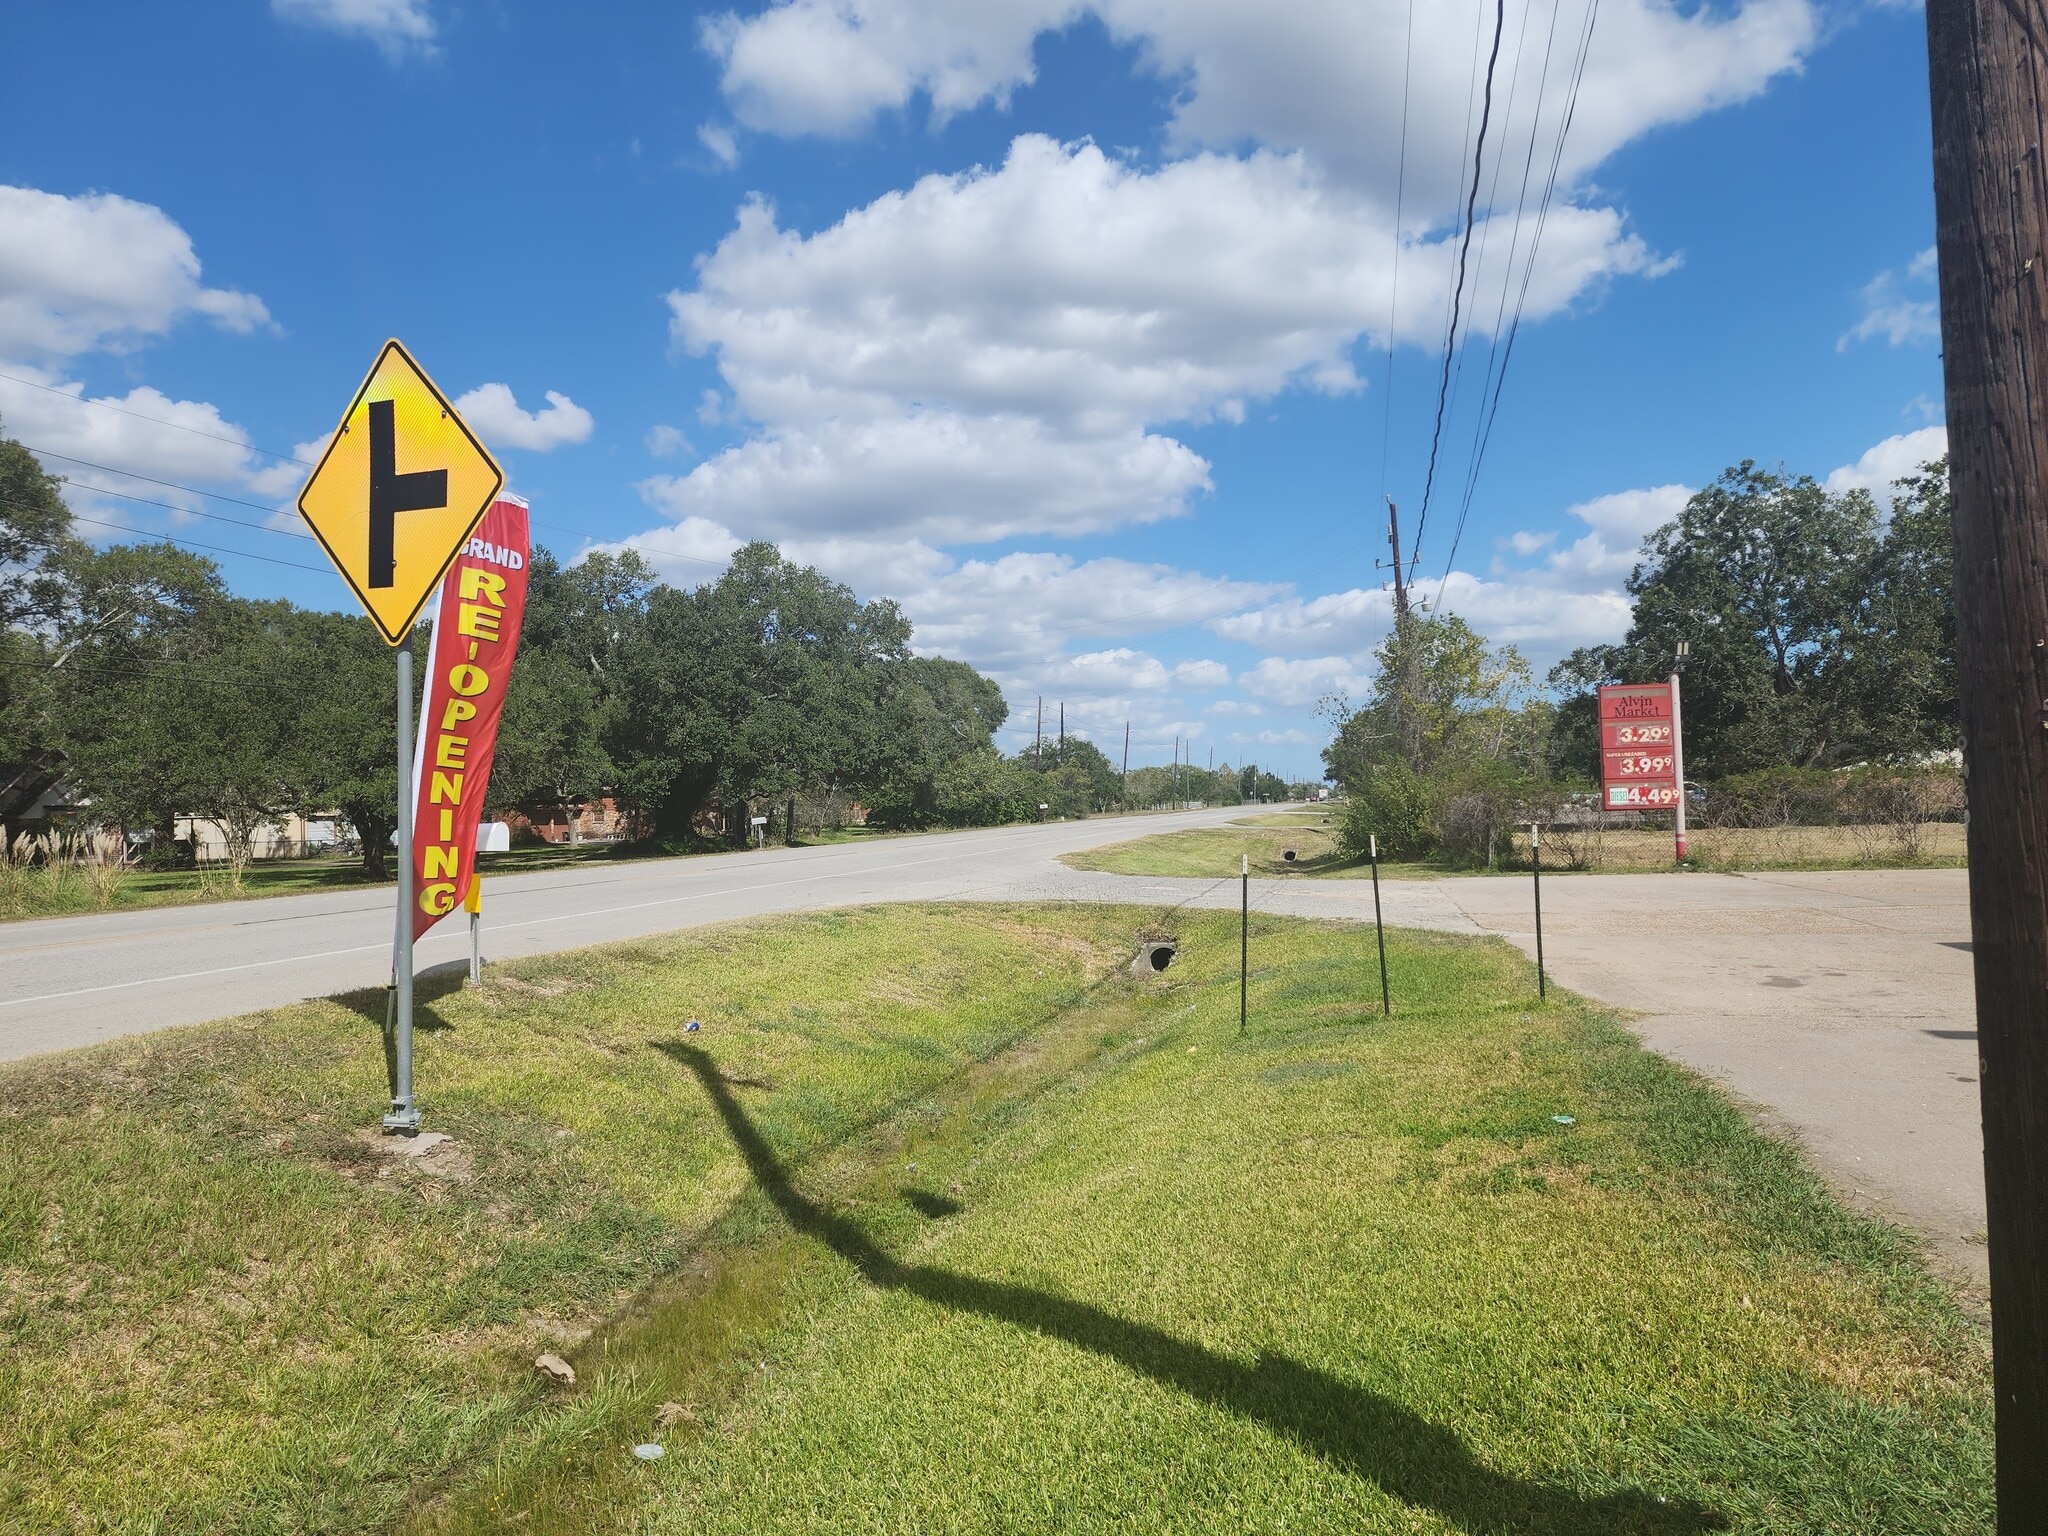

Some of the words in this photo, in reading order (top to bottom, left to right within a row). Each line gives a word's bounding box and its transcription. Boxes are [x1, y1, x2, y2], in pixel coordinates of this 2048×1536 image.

[1619, 695, 1653, 707] Alvin
[1614, 704, 1660, 717] Market
[1611, 790, 1628, 801] DIESEL
